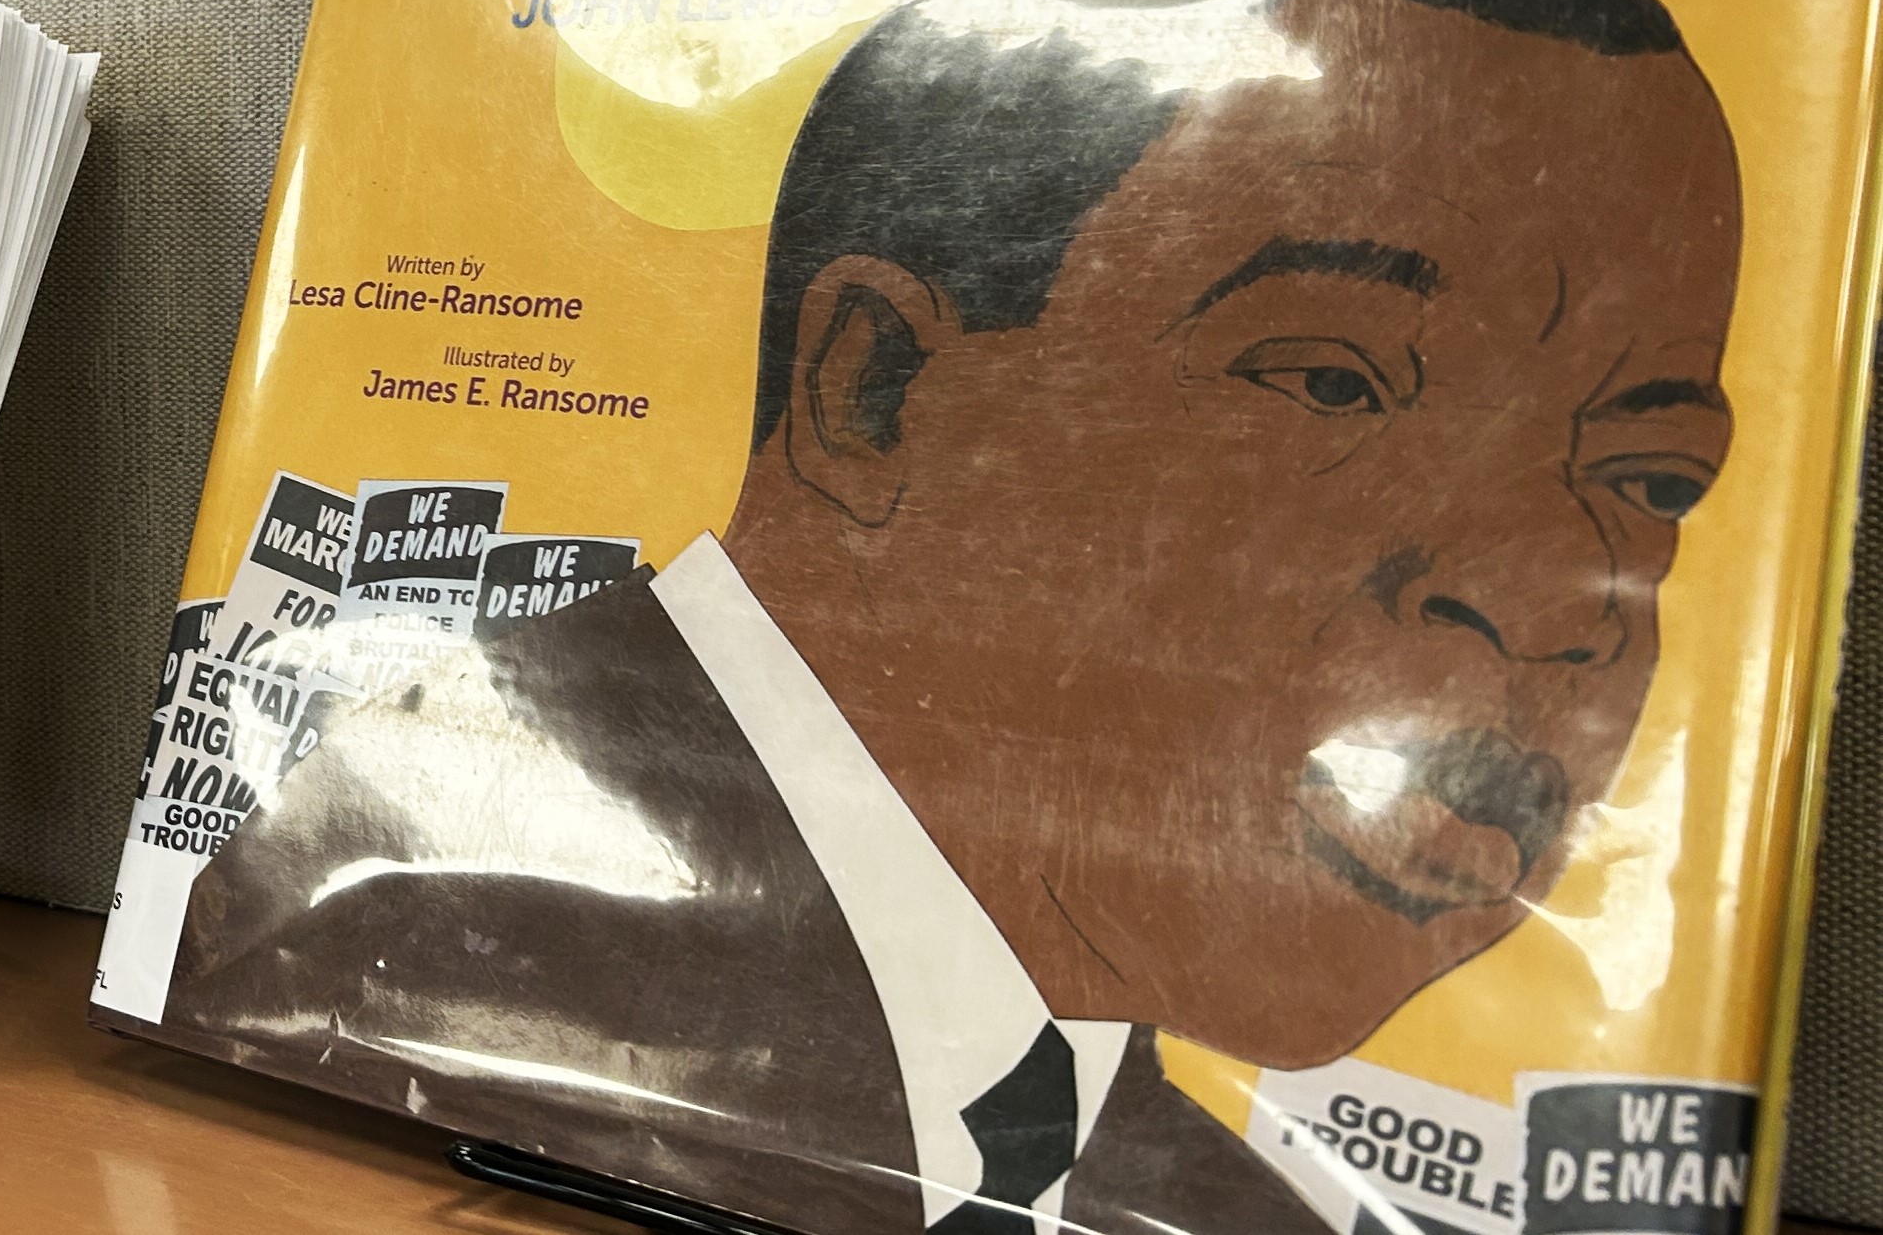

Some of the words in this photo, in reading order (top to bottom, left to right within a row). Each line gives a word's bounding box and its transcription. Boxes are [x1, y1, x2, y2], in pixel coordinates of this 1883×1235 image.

[387, 255, 454, 276] Written
[461, 255, 485, 281] by
[289, 280, 344, 307] Lesa
[354, 281, 583, 320] Cline-Ransome
[444, 346, 542, 371] Illustrated
[549, 354, 575, 377] by
[363, 370, 457, 404] James
[467, 377, 490, 407] E.
[501, 380, 650, 419] Ransome
[317, 505, 354, 542] WE
[408, 492, 452, 524] WE
[364, 524, 488, 563] DEMAND
[534, 545, 580, 578] WE
[359, 584, 390, 602] AN
[396, 586, 440, 604] END
[1329, 1093, 1483, 1167] GOOD
[1620, 1093, 1703, 1145] WE
